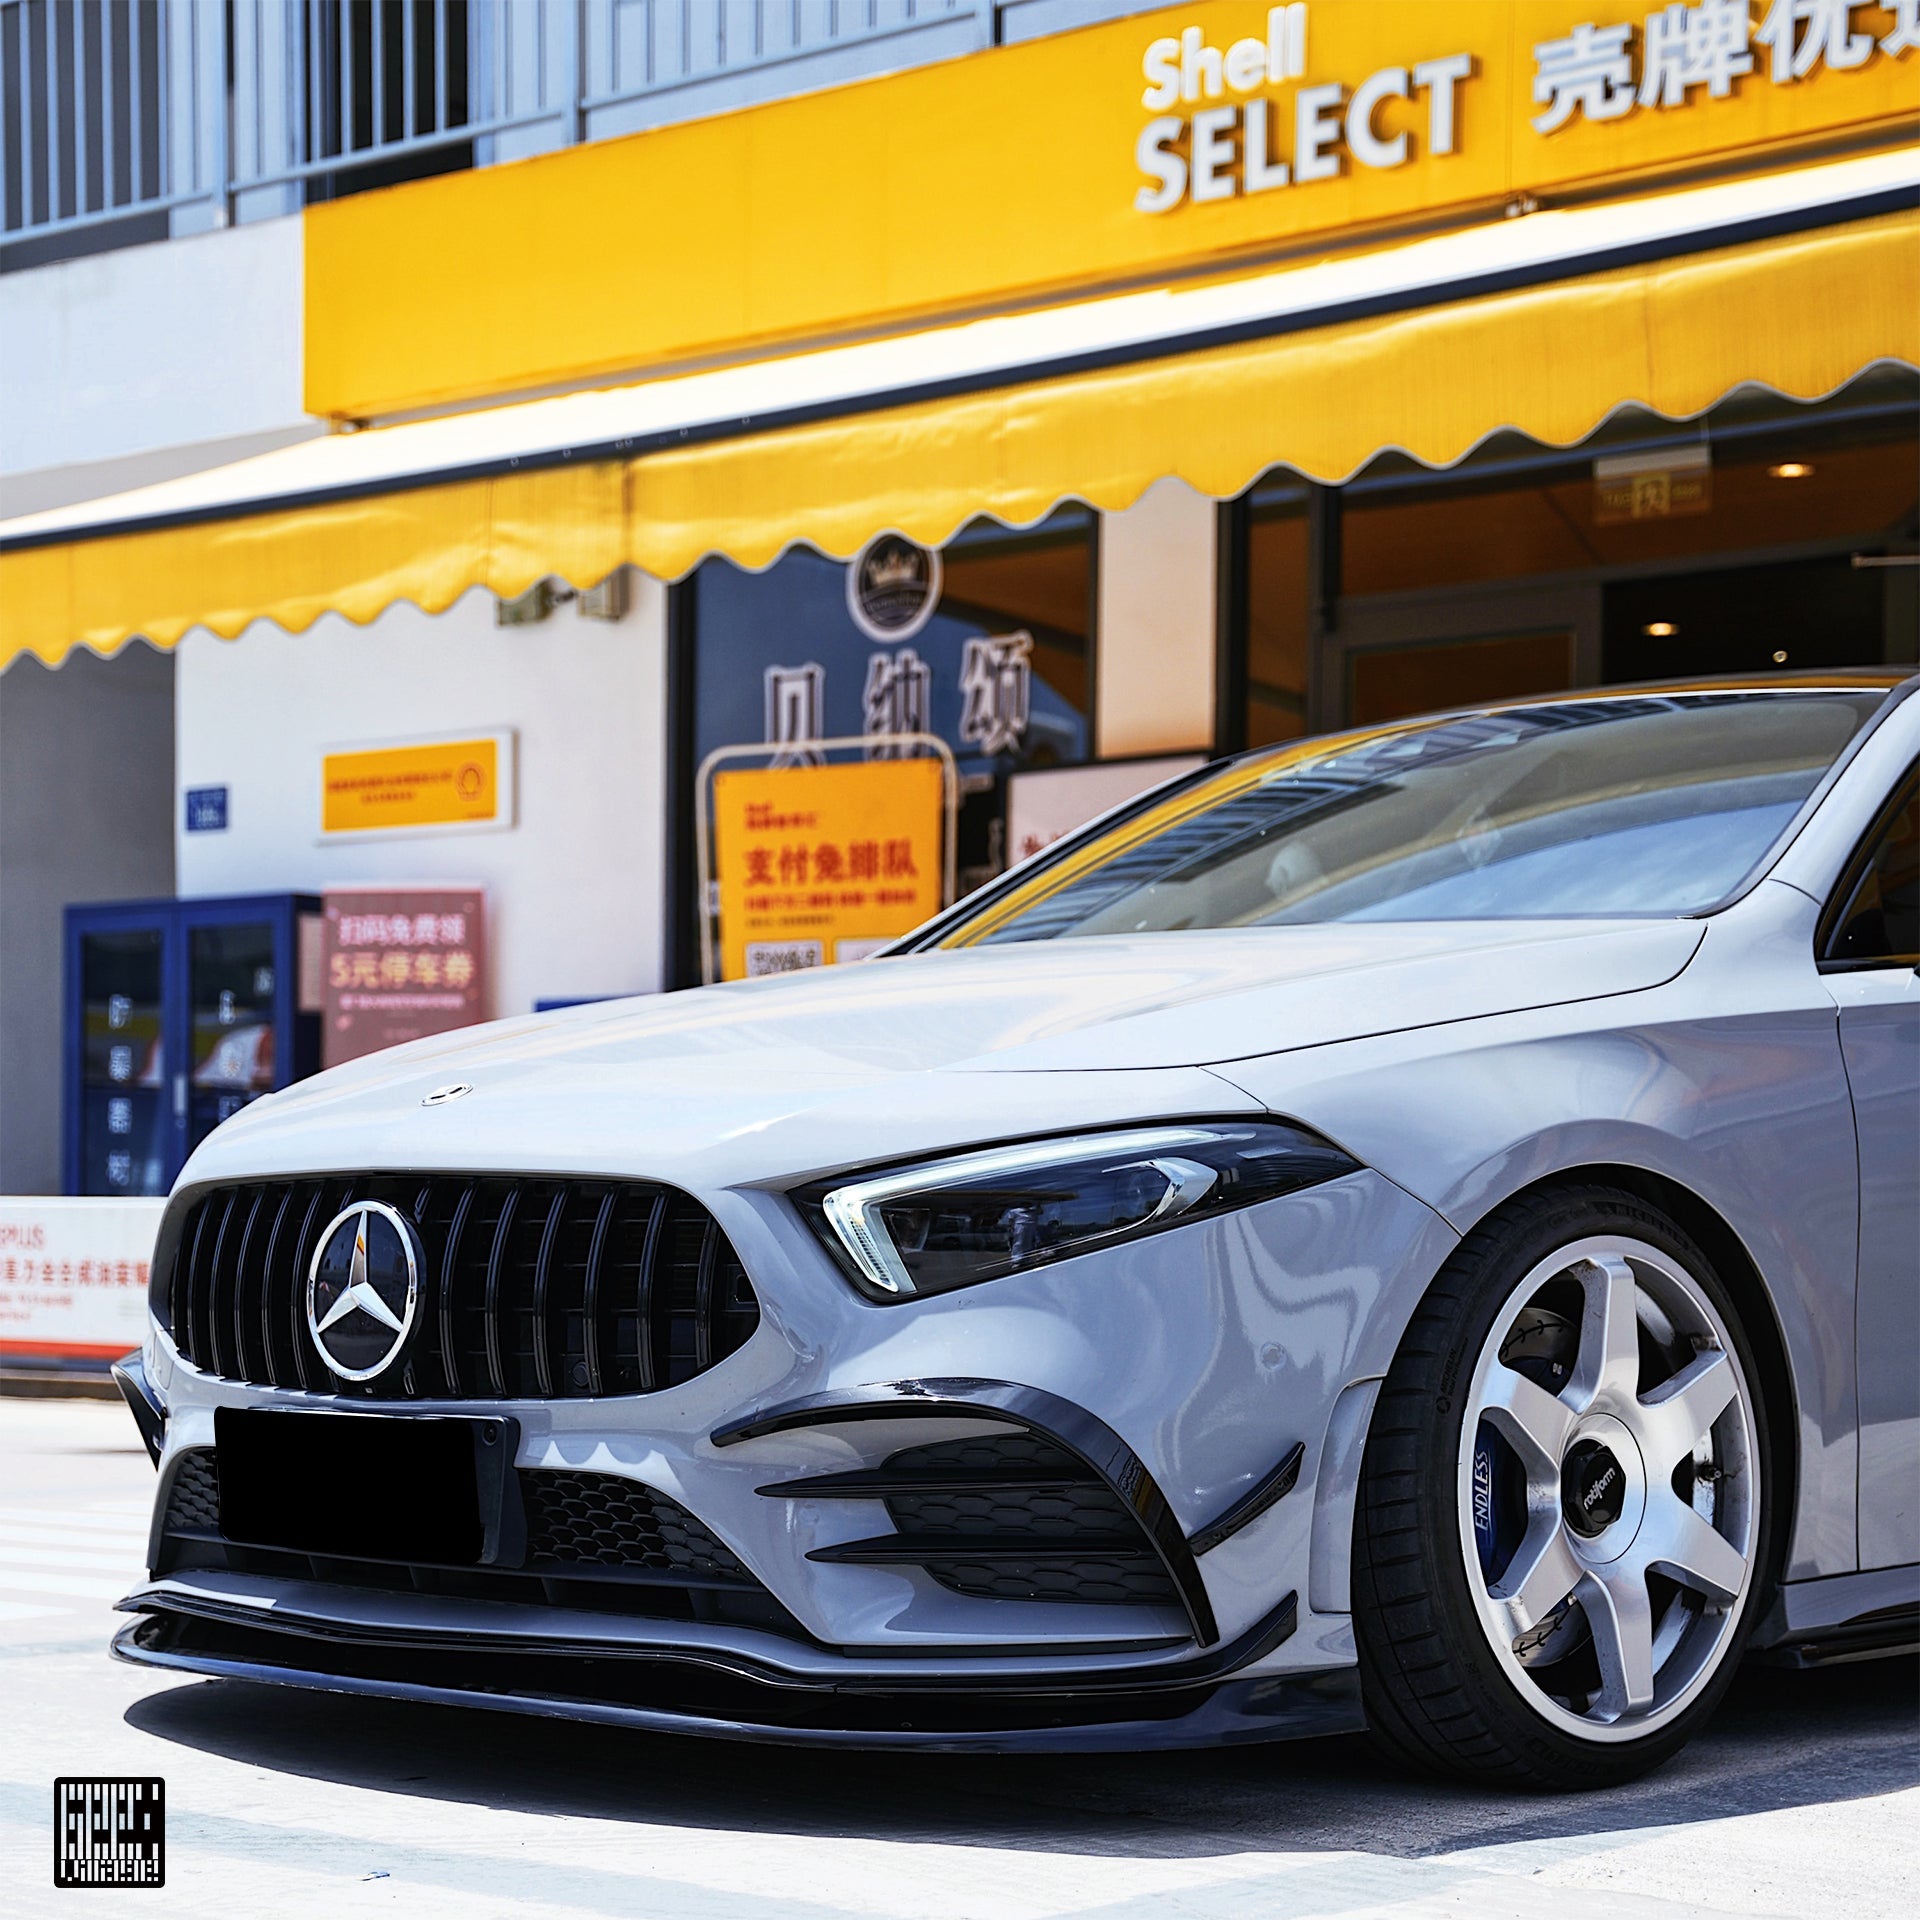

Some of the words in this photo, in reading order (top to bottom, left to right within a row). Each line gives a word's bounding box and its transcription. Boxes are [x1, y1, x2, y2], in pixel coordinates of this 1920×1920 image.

[1141, 2, 1308, 111] Shell
[1134, 53, 1471, 213] SELECT
[1473, 1449, 1490, 1532] ENDLESS
[1583, 1466, 1617, 1511] rotiform
